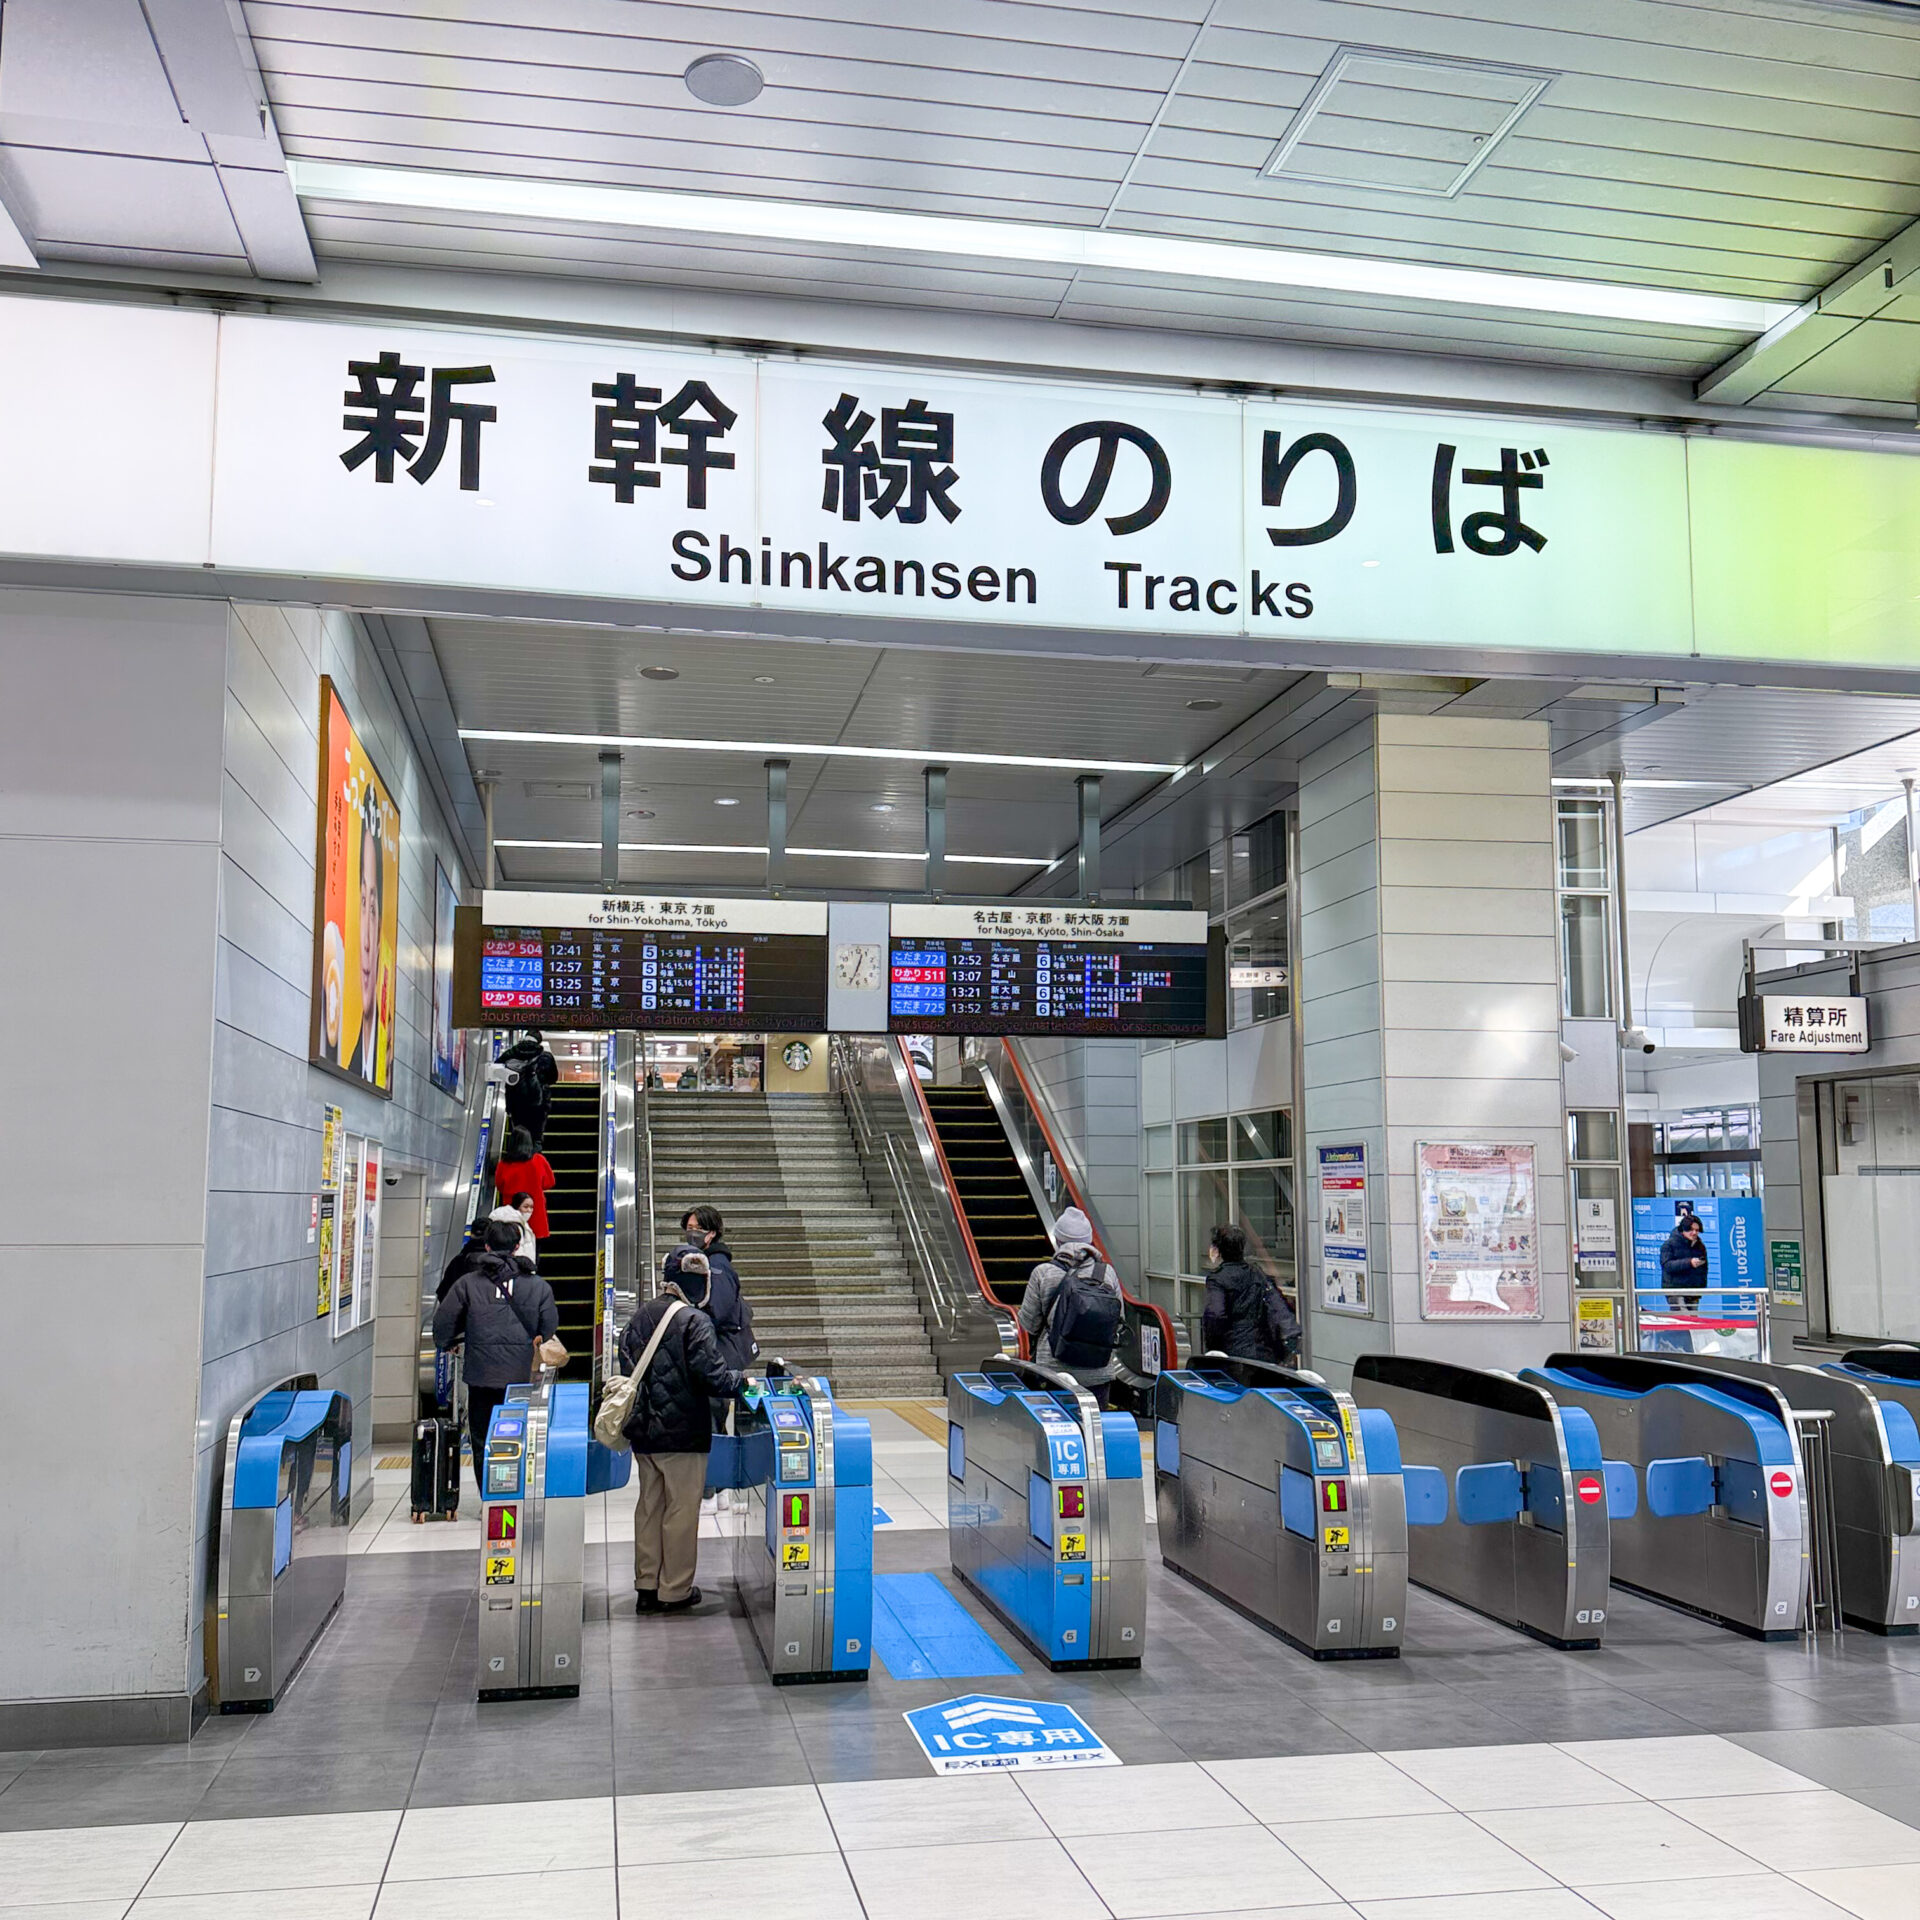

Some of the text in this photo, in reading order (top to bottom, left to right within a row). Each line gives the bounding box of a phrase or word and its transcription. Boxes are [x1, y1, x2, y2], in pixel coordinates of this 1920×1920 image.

[339, 351, 1550, 557] 新幹線のりば
[670, 530, 1314, 620] Shinkansen Tracks
[602, 899, 716, 916] 新横浜・東京 方面
[589, 914, 603, 923] for
[607, 915, 693, 927] Shin-Yokohama,
[1108, 915, 1129, 926] 方面
[978, 925, 992, 934] for
[995, 925, 1034, 936] Nagoya,
[486, 941, 516, 949] ひかり
[519, 943, 542, 954] 504
[550, 945, 581, 956] 12:41
[593, 944, 620, 953] 東京
[645, 947, 654, 958] 5
[661, 949, 674, 957] 1-5
[486, 959, 693, 974] こだま 718 12:57 東京 5 1-6,15,16
[925, 954, 944, 964] 721
[952, 955, 982, 965] 12:52
[991, 954, 1021, 963] 名古屋
[1040, 956, 1048, 966] 6
[1053, 955, 1084, 963] 1-6,15,16
[894, 969, 921, 977] ひかり
[924, 970, 944, 980] 511
[952, 971, 981, 981] 13:07
[991, 970, 1016, 979] 岡山
[1039, 972, 1047, 982] 6
[486, 975, 693, 991] こだま 720 13:25 東京 5 1-6,15,16
[895, 985, 920, 993] こだま
[924, 987, 944, 997] 723
[951, 987, 981, 997] 13:21
[991, 986, 1020, 995] 新大阪
[1039, 987, 1047, 998] 6
[485, 992, 514, 1001] ひかり
[518, 994, 541, 1005] 506
[549, 995, 580, 1006] 13:41
[592, 994, 620, 1003] 東京
[645, 997, 653, 1007] 5
[660, 999, 672, 1007] 1-5
[895, 1001, 920, 1009] こだま
[924, 1003, 944, 1013] 725
[951, 1003, 981, 1013] 13:52
[991, 1002, 1020, 1011] 名古屋
[1039, 1004, 1047, 1014] 6
[1784, 1006, 1847, 1027] 精算所
[1771, 1030, 1863, 1046] Fare Adjustment
[1735, 1216, 1749, 1275] amazon
[1055, 1440, 1079, 1461] IC
[1057, 1462, 1080, 1476] 専用
[1777, 1603, 1785, 1613] 2
[1580, 1612, 1587, 1622] 3
[1593, 1611, 1602, 1621] 2
[1330, 1622, 1339, 1631] 4
[1385, 1620, 1394, 1629] 3
[1066, 1632, 1075, 1642] 5
[1123, 1629, 1133, 1639] 4
[788, 1644, 796, 1653] 6
[849, 1641, 857, 1651] 5
[493, 1660, 501, 1670] 7
[557, 1656, 566, 1666] 6
[248, 1671, 256, 1679] 7
[932, 1727, 1086, 1752] IC専用
